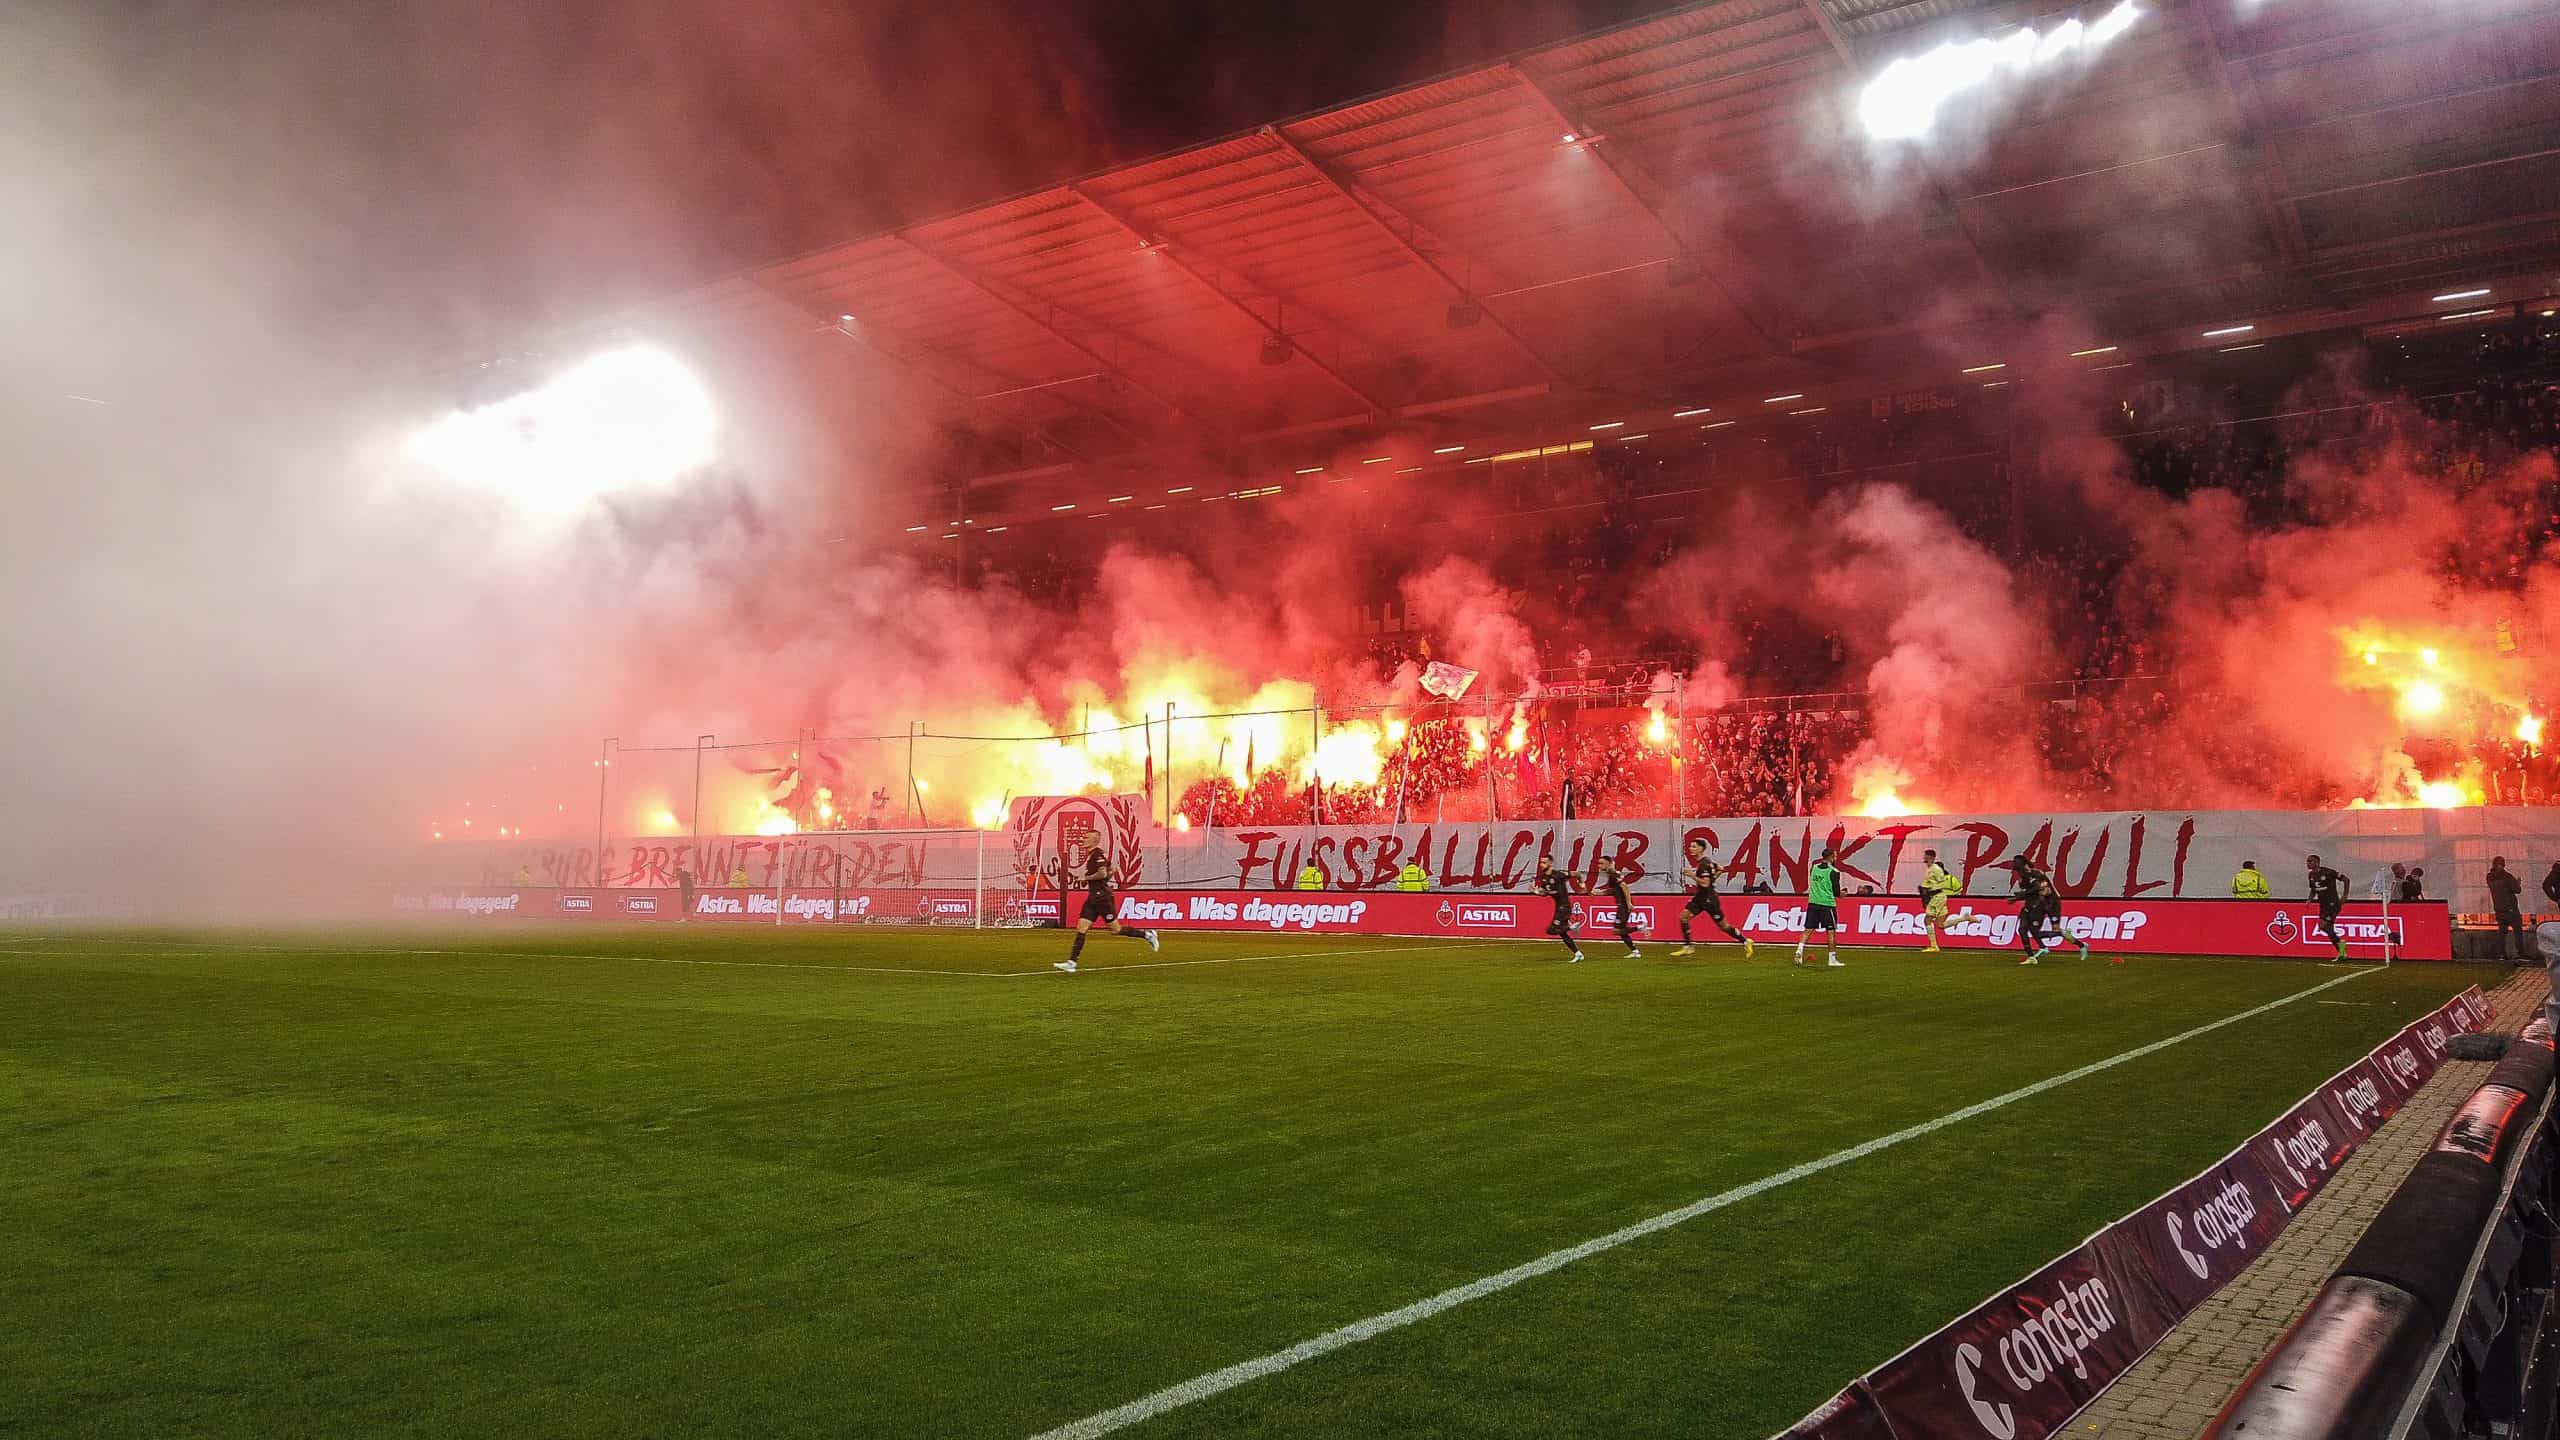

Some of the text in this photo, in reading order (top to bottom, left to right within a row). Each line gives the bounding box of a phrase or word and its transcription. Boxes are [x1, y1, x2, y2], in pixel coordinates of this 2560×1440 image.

[624, 840, 762, 889] BRENNT
[764, 838, 834, 889] FÜR
[851, 838, 927, 890] DEN
[1684, 818, 1942, 895] SANKT
[1945, 814, 2195, 897] PAULI
[629, 900, 655, 911] ASTRA
[696, 894, 743, 914] Astra.
[747, 895, 779, 914] Was
[935, 903, 968, 914] ASTRA
[1024, 904, 1058, 914] ASTRA
[1117, 897, 1366, 929] Astra. Was dagegen?
[1462, 910, 1511, 922] ASTRA
[1596, 911, 1649, 924] ASRA
[1743, 903, 2147, 947] Ast. Was daggen?
[2311, 922, 2392, 938] ASTRA
[2287, 1117, 2331, 1171] congstar
[2193, 1178, 2257, 1249] congstar
[2000, 1277, 2116, 1391] congstar
